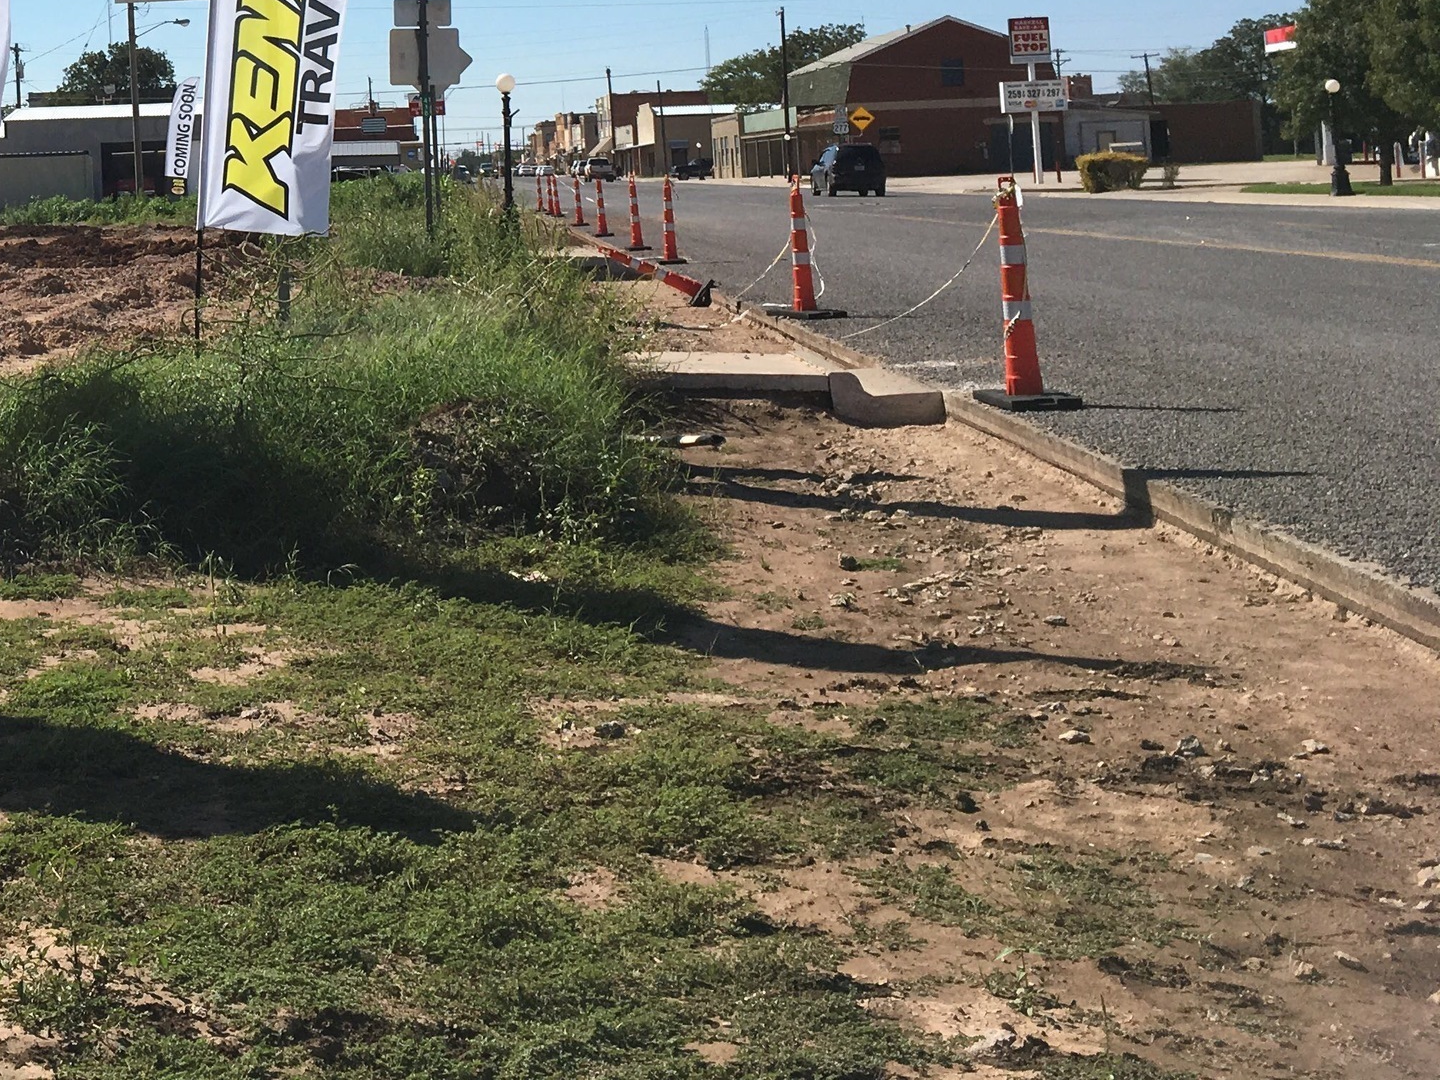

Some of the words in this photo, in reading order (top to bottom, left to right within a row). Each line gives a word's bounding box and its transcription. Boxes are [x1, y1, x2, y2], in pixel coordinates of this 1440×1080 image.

[1013, 33, 1047, 42] FUEL
[1014, 42, 1048, 52] STOP
[178, 84, 197, 122] SOON
[834, 124, 847, 132] 277
[173, 123, 191, 176] COMING
